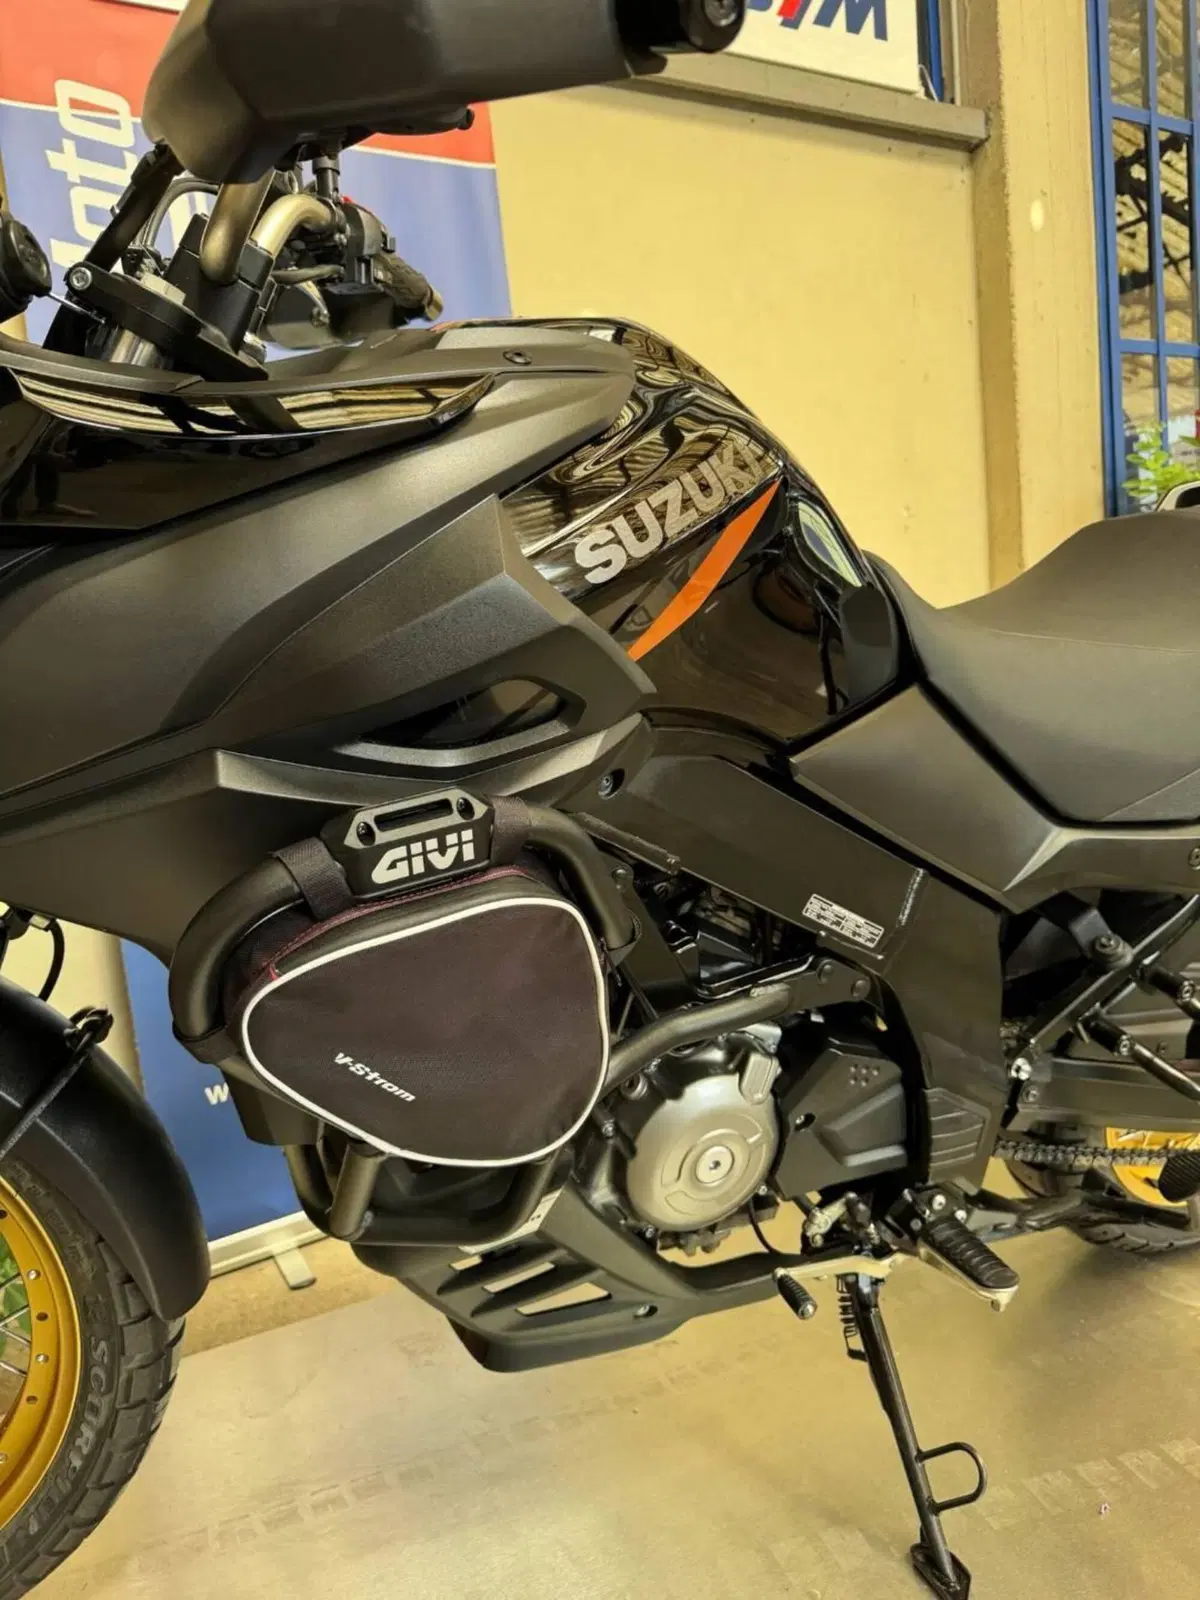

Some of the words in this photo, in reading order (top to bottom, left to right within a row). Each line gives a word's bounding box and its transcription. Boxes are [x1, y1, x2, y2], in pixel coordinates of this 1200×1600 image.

[45, 79, 141, 272] oto
[575, 437, 764, 584] SUZUKI
[371, 828, 475, 884] GIVI
